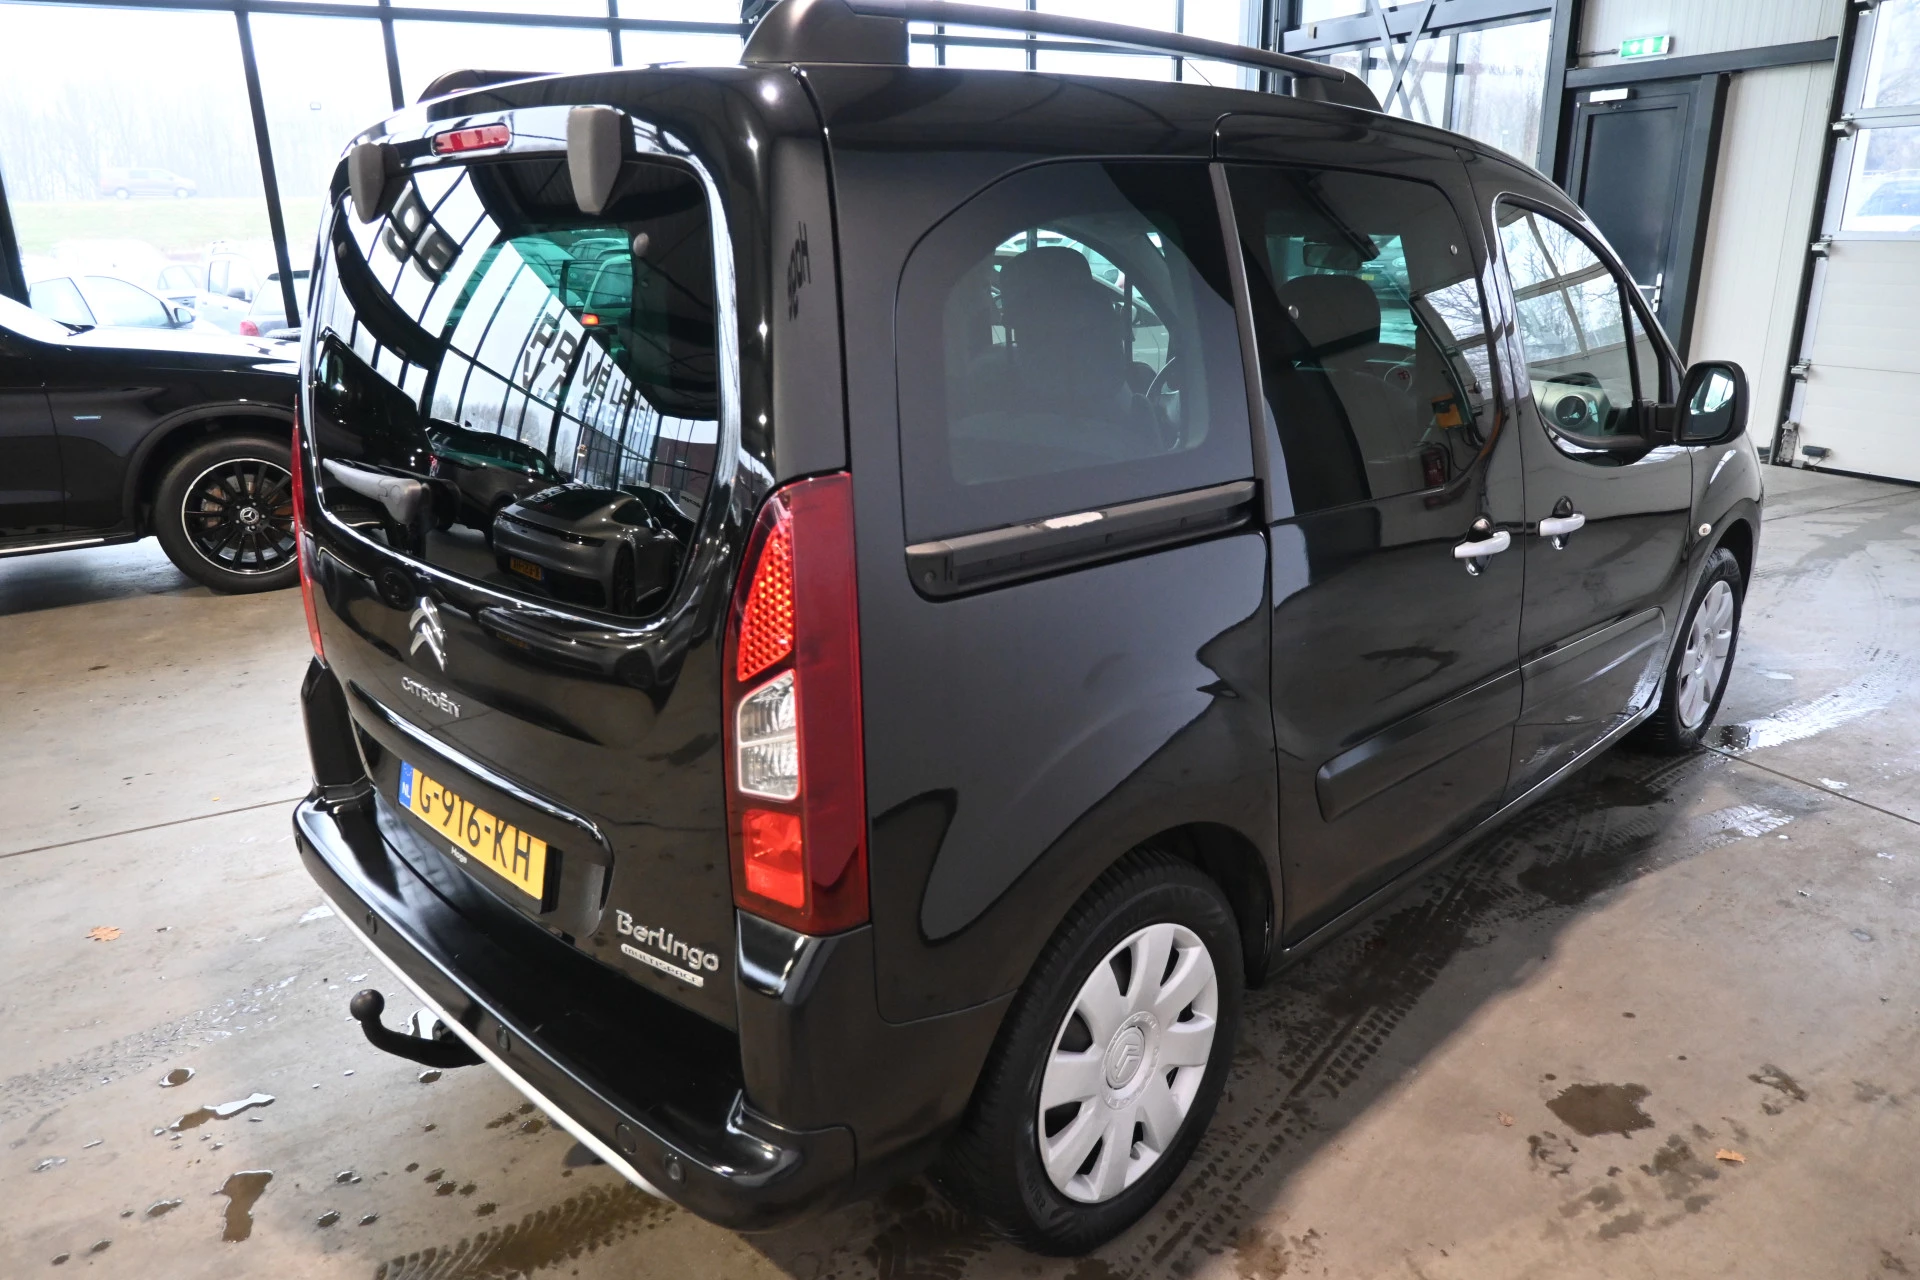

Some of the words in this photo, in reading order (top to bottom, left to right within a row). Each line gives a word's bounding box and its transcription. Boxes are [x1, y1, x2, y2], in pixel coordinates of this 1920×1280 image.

[401, 676, 460, 718] CITROËN
[401, 781, 411, 799] NL
[419, 773, 532, 883] G-916-KH
[616, 909, 719, 971] Berlingo
